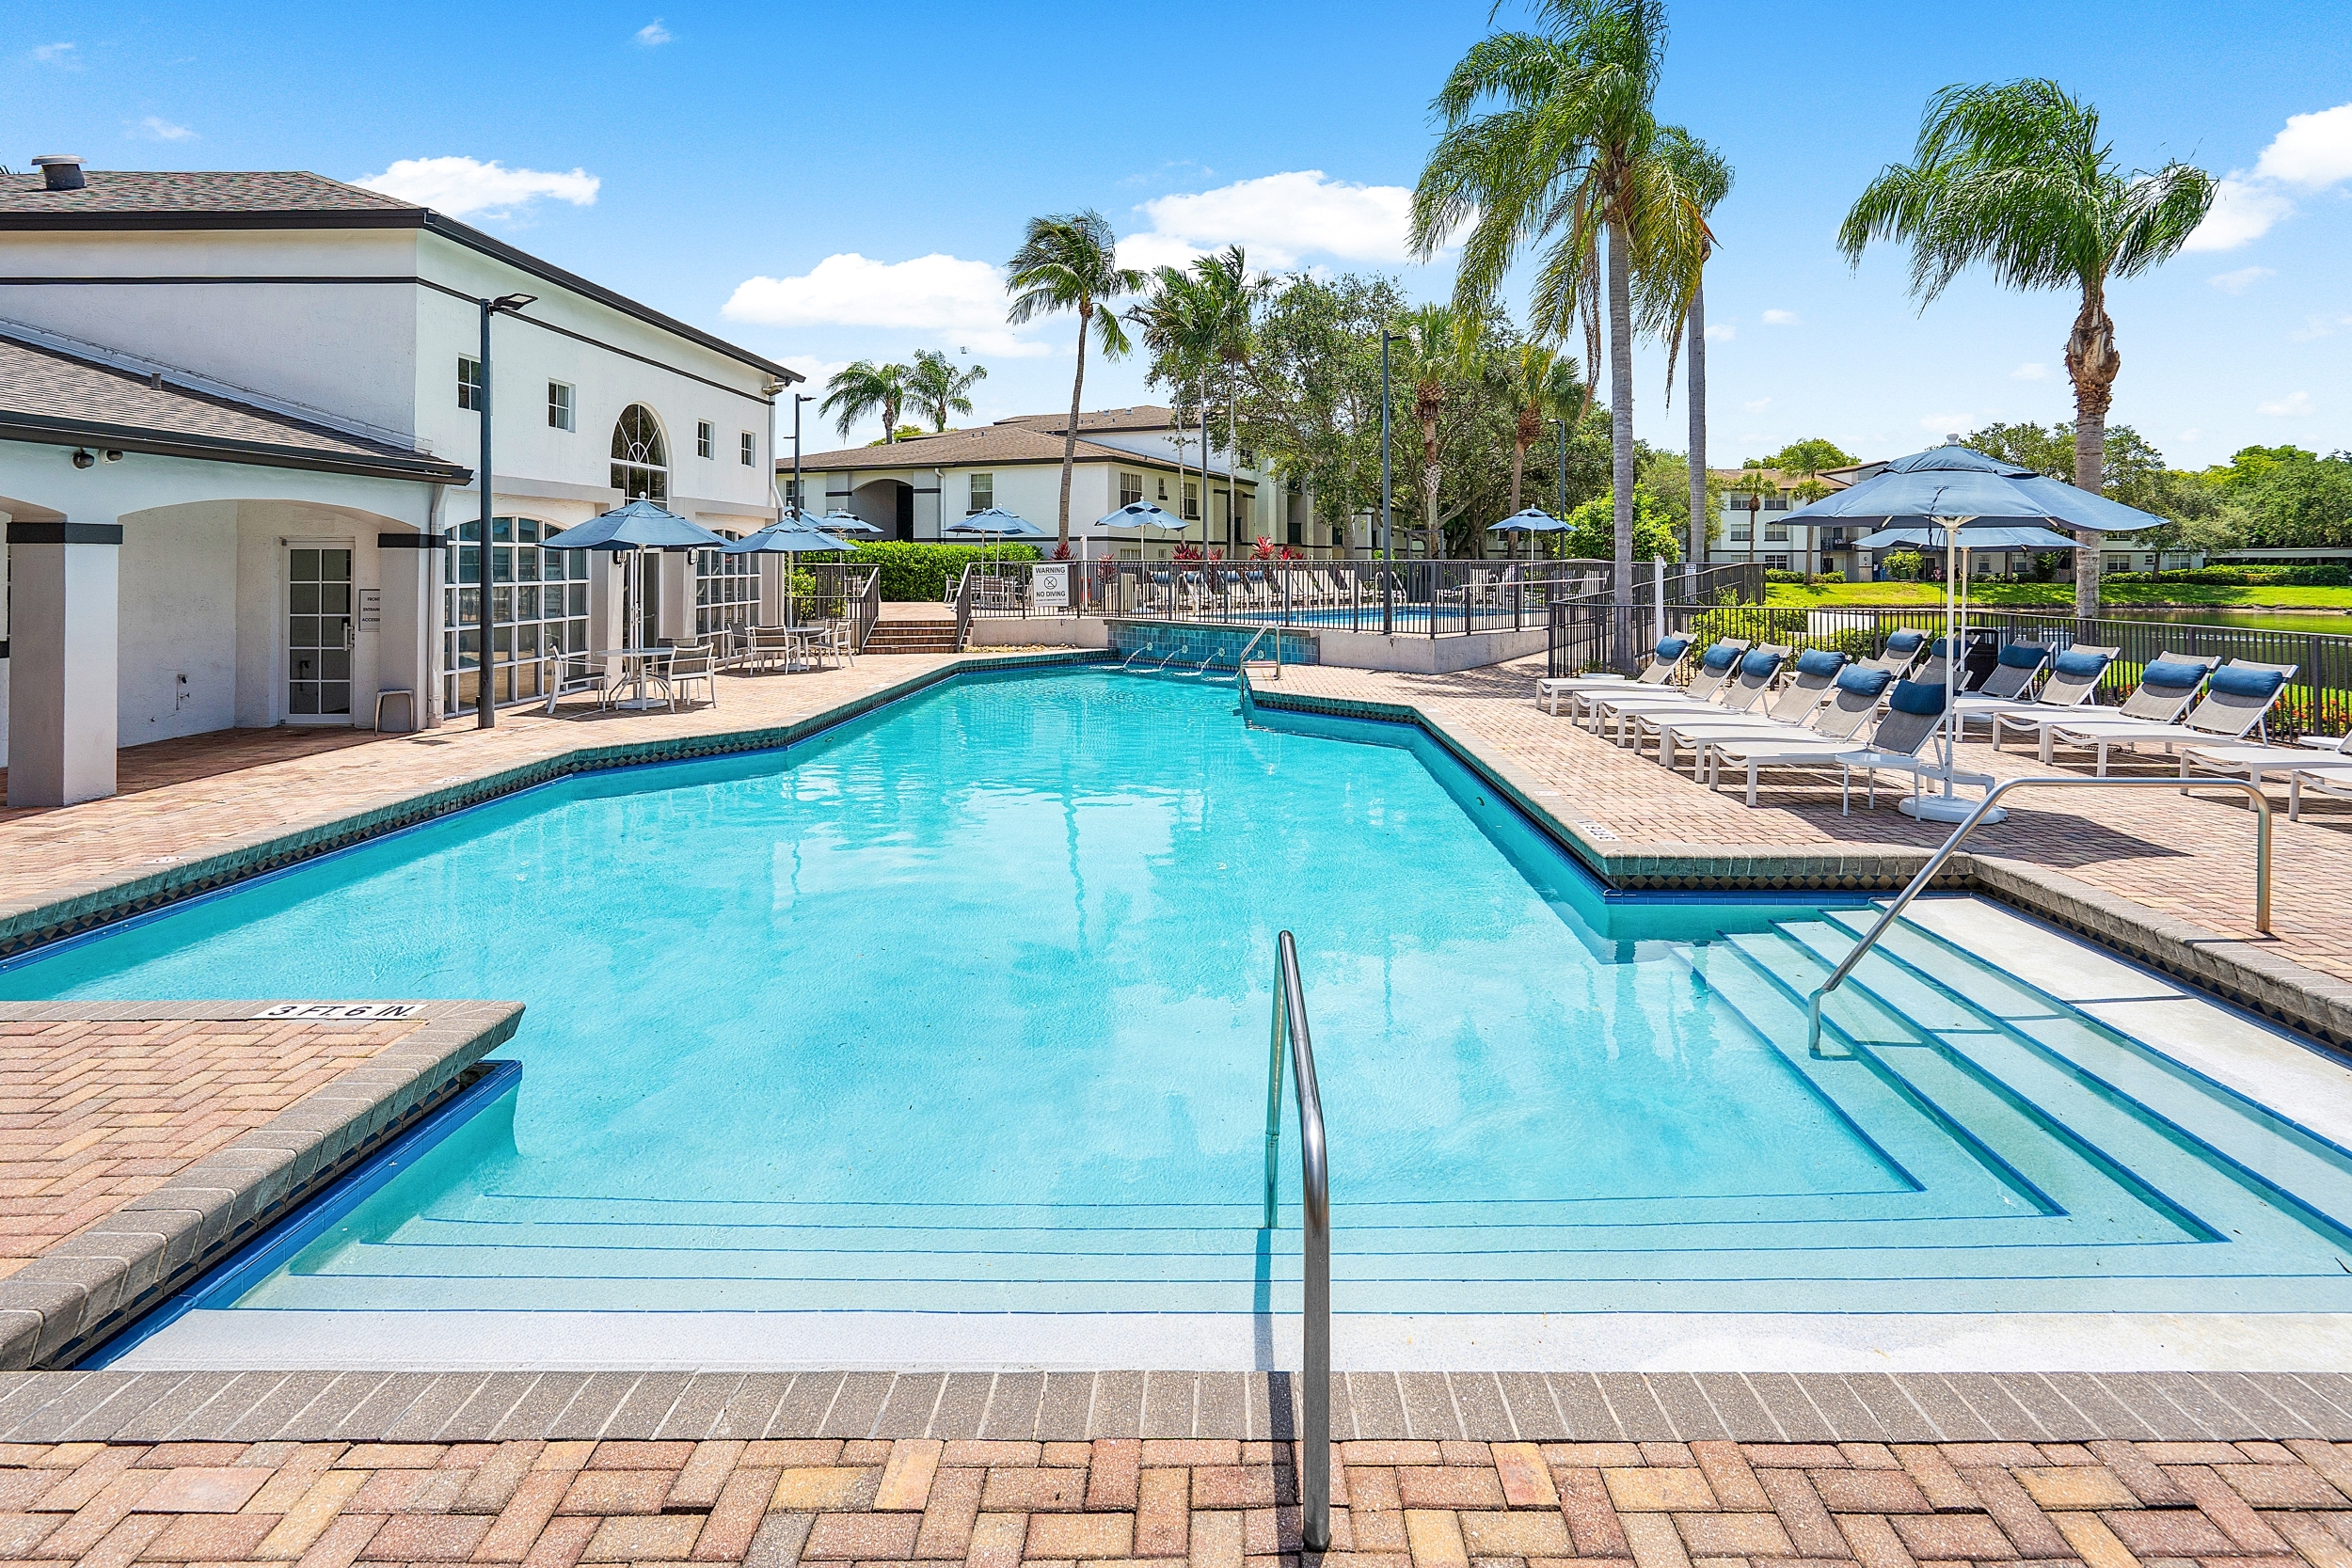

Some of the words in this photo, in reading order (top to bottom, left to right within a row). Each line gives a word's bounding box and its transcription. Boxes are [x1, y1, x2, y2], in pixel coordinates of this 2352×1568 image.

[438, 801, 445, 814] 4
[268, 1006, 298, 1016] 3
[297, 1006, 346, 1016] FT.
[344, 1006, 373, 1016] 6
[373, 1006, 416, 1017] IN.
